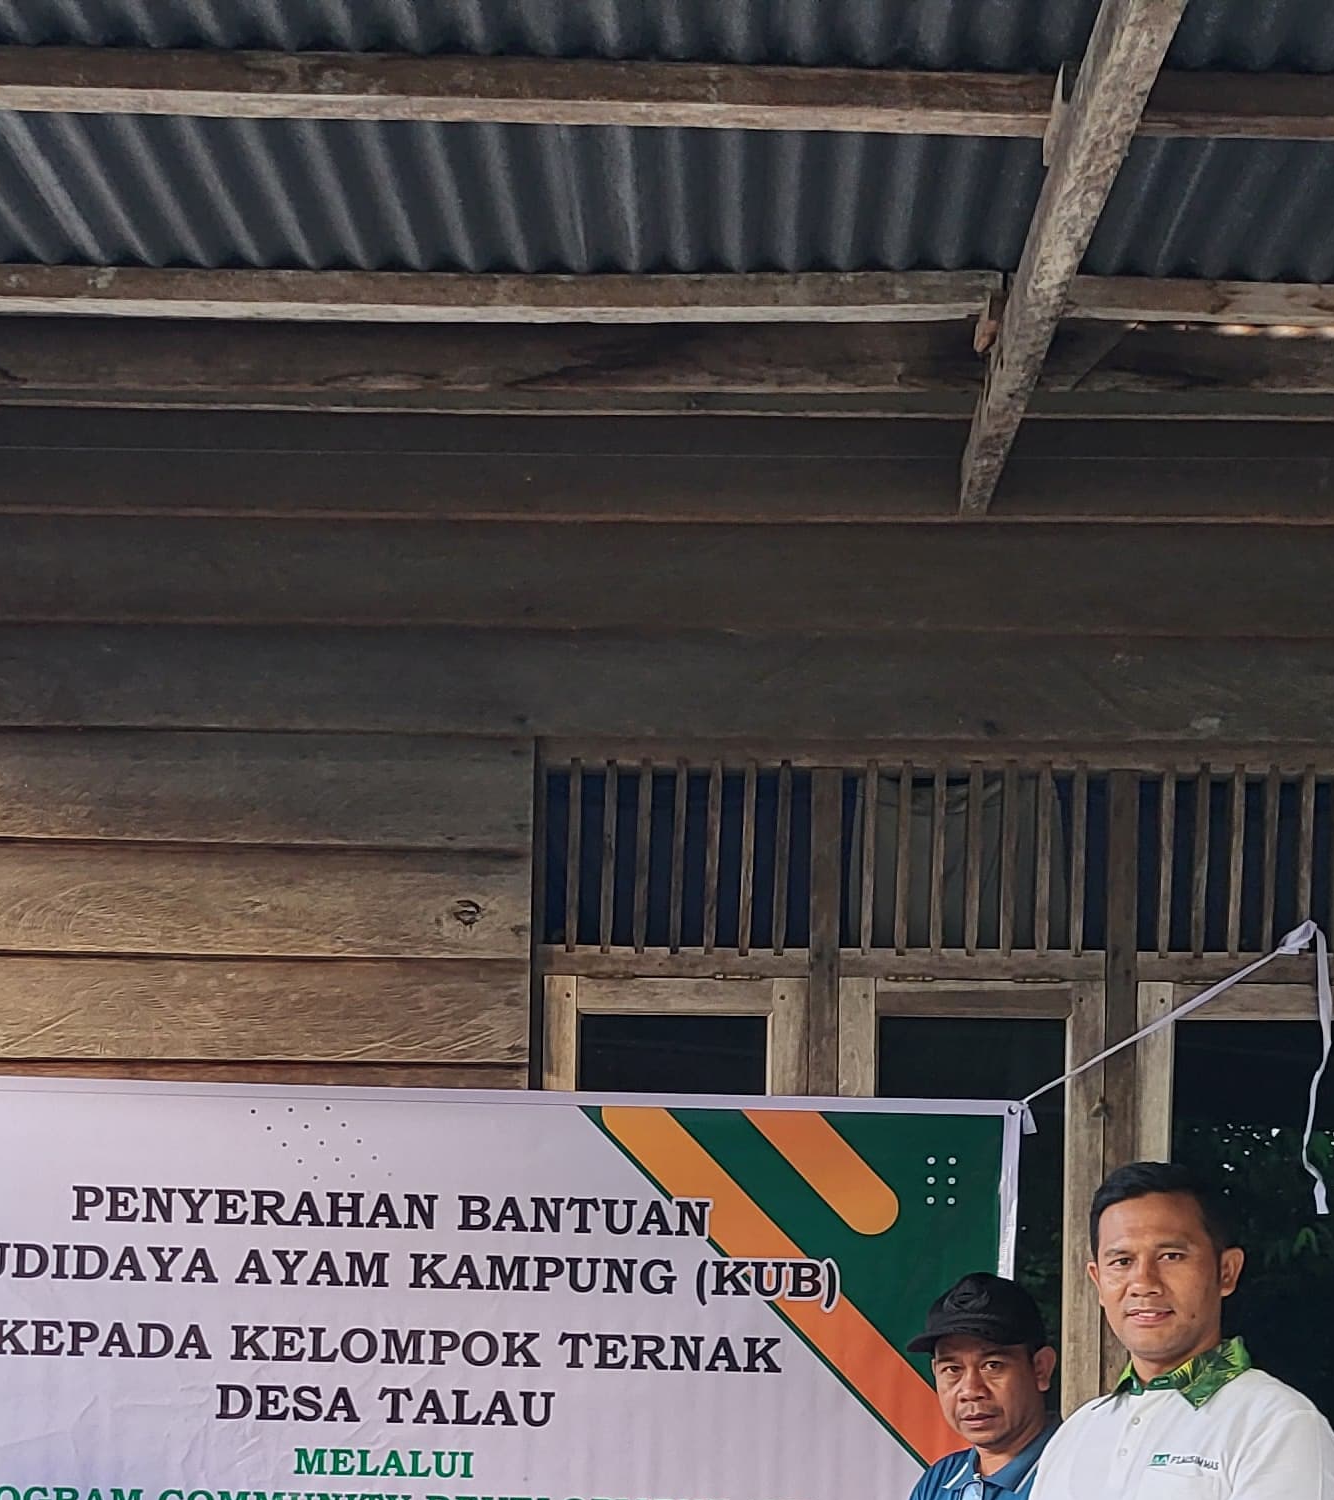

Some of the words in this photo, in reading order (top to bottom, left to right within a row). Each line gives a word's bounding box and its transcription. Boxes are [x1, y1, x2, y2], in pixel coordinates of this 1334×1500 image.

[71, 1184, 438, 1231] PENYERAHAN
[457, 1194, 710, 1238] BANTUAN
[234, 1247, 390, 1288] AYAM
[408, 1252, 678, 1295] KAMPUNG
[695, 1258, 839, 1311] (KUB)
[230, 1324, 542, 1369] KELOMPOK
[557, 1331, 783, 1374] TERNAK
[215, 1383, 361, 1423] DESA
[378, 1386, 556, 1428] TALAU
[293, 1447, 475, 1480] MELALUI
